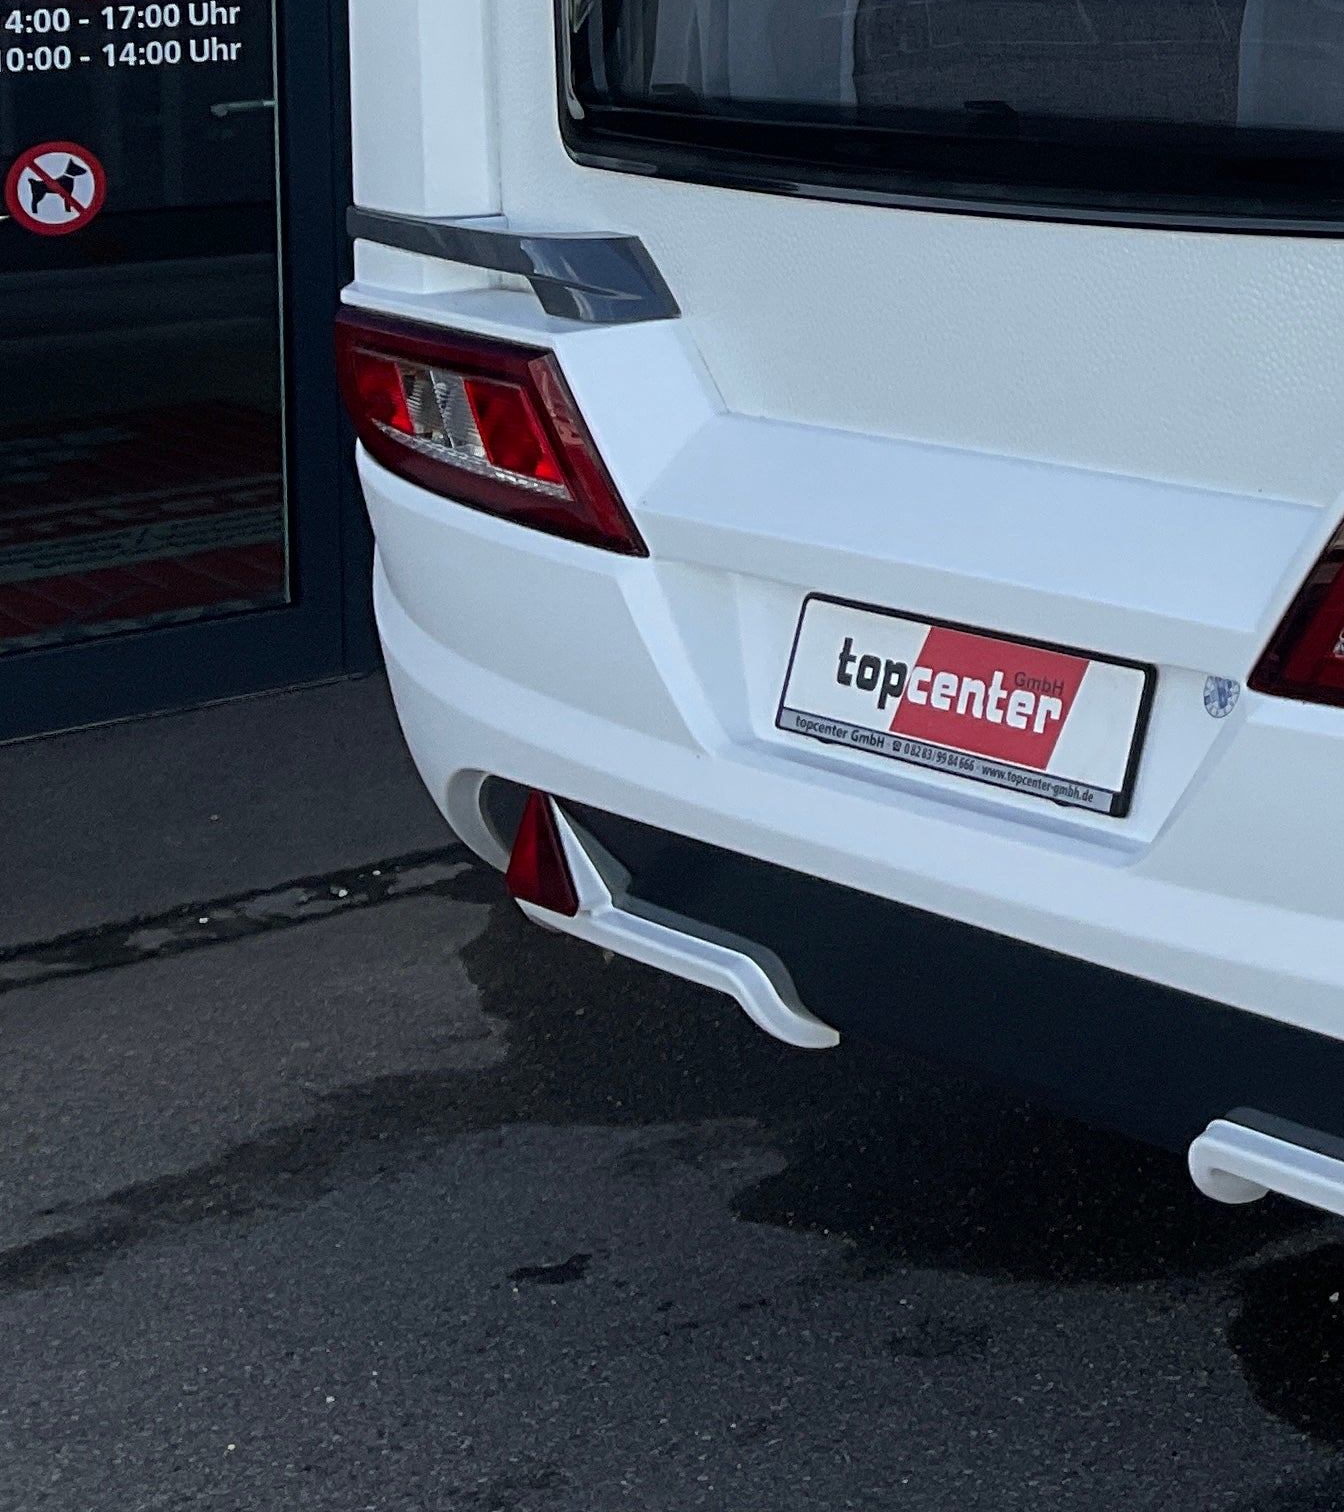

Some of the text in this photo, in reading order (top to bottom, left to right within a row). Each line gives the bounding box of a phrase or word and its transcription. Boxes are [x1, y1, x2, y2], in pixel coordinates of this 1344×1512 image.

[100, 3, 181, 30] 17:00
[188, 1, 241, 26] Uhr
[0, 45, 72, 73] 0:00
[102, 40, 182, 67] 14:00
[189, 37, 242, 63] Uhr
[836, 637, 1064, 735] topcenter
[1013, 671, 1065, 696] GmbH
[795, 715, 848, 738] topcenter
[850, 729, 885, 749] GmbH
[981, 764, 1094, 803] www.topcenter-gmbh.de
